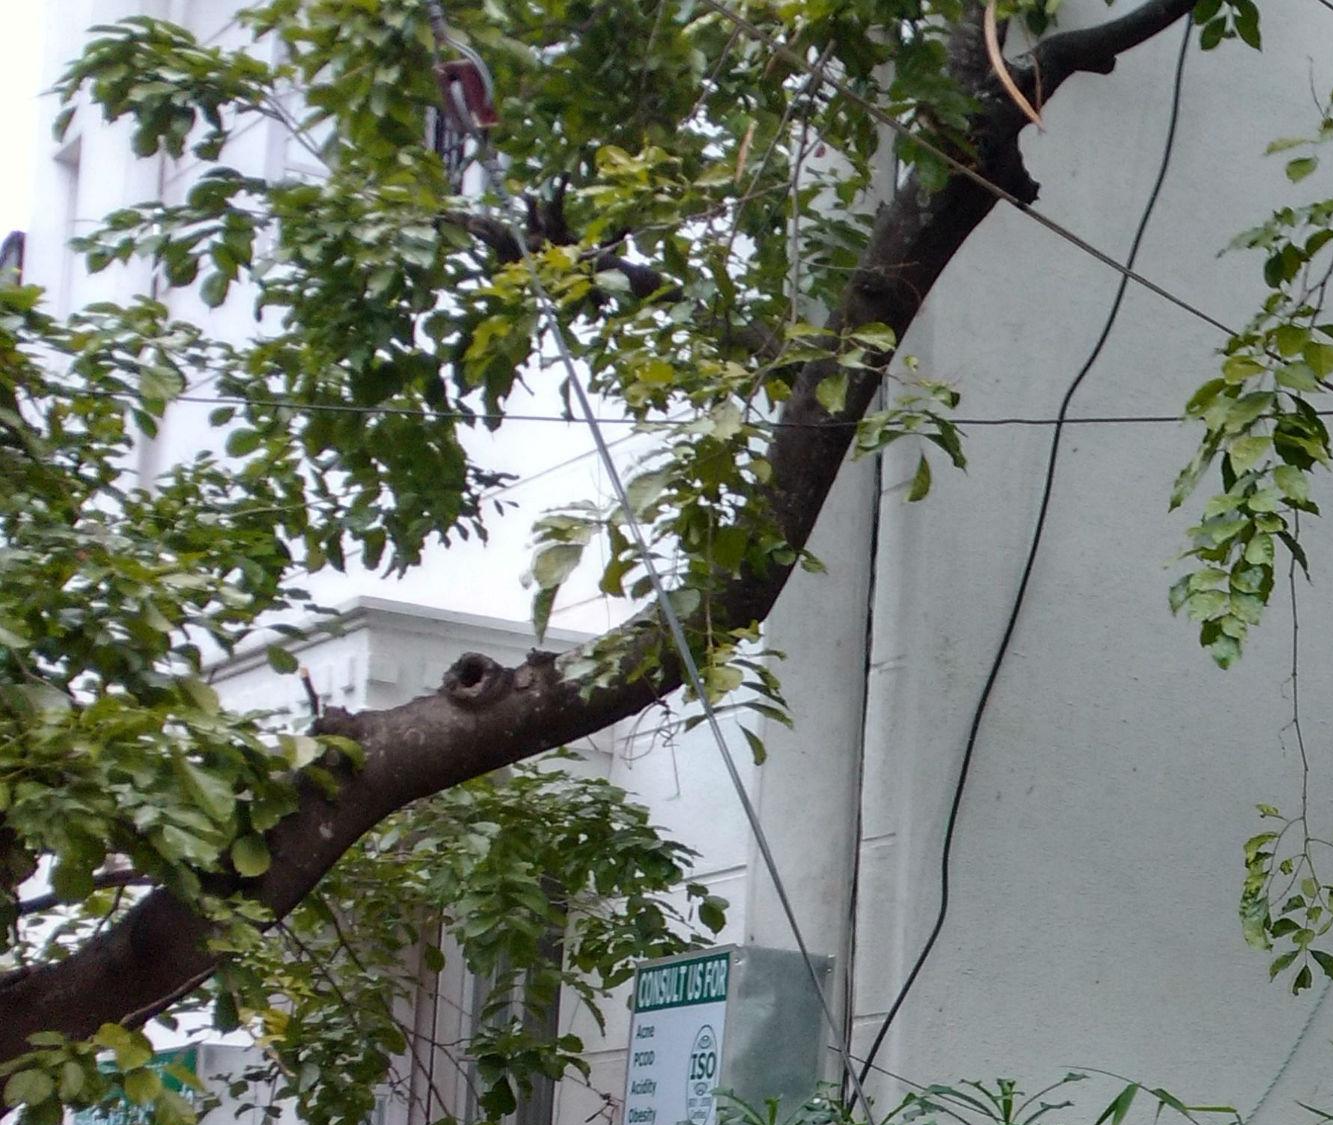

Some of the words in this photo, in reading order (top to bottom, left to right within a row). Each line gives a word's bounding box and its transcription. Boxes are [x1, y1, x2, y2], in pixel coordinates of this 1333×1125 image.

[638, 966, 688, 1008] CONSULT
[687, 963, 704, 1000] US
[703, 959, 727, 998] FOR
[635, 1025, 655, 1039] Acne
[690, 1051, 717, 1080] ISO
[631, 1078, 657, 1097] Acidity
[628, 1107, 656, 1125] Obesity
